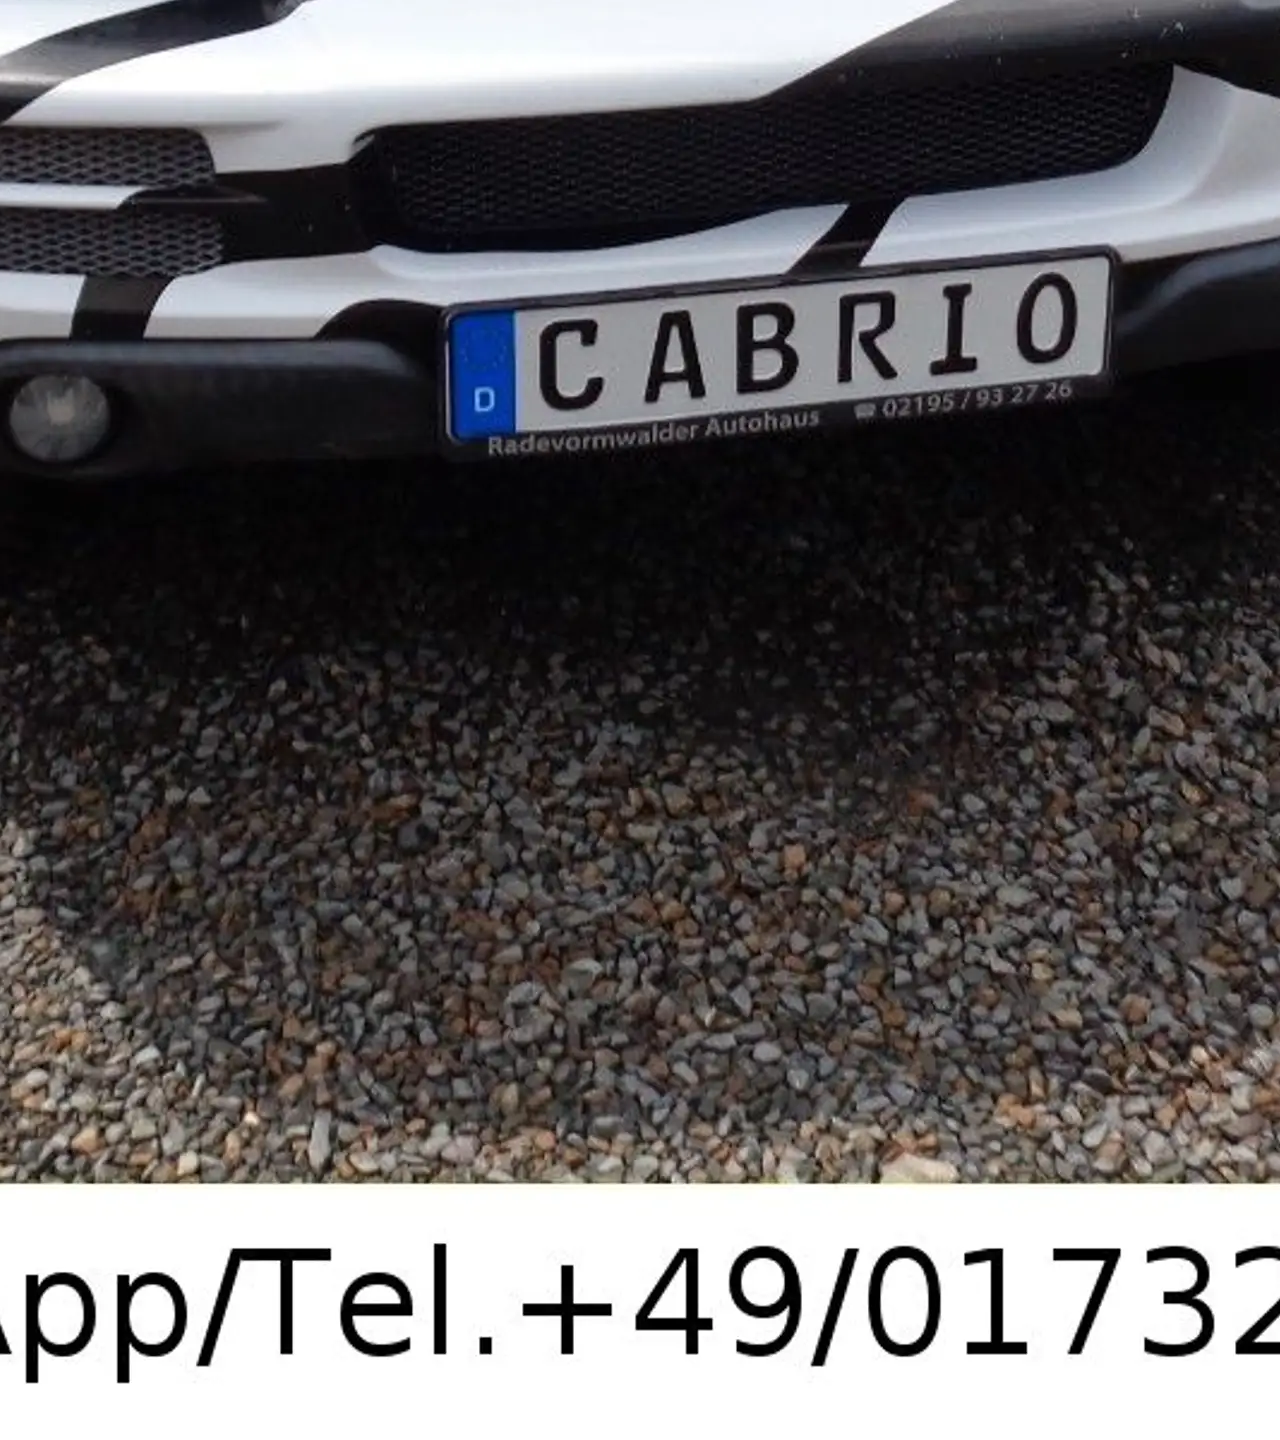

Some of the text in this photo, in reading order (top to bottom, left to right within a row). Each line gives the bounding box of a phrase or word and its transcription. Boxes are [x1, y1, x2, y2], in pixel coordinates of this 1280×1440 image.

[538, 272, 1078, 411] CABRIO
[474, 386, 495, 412] D
[488, 409, 820, 456] Radevormwalder Autohaus
